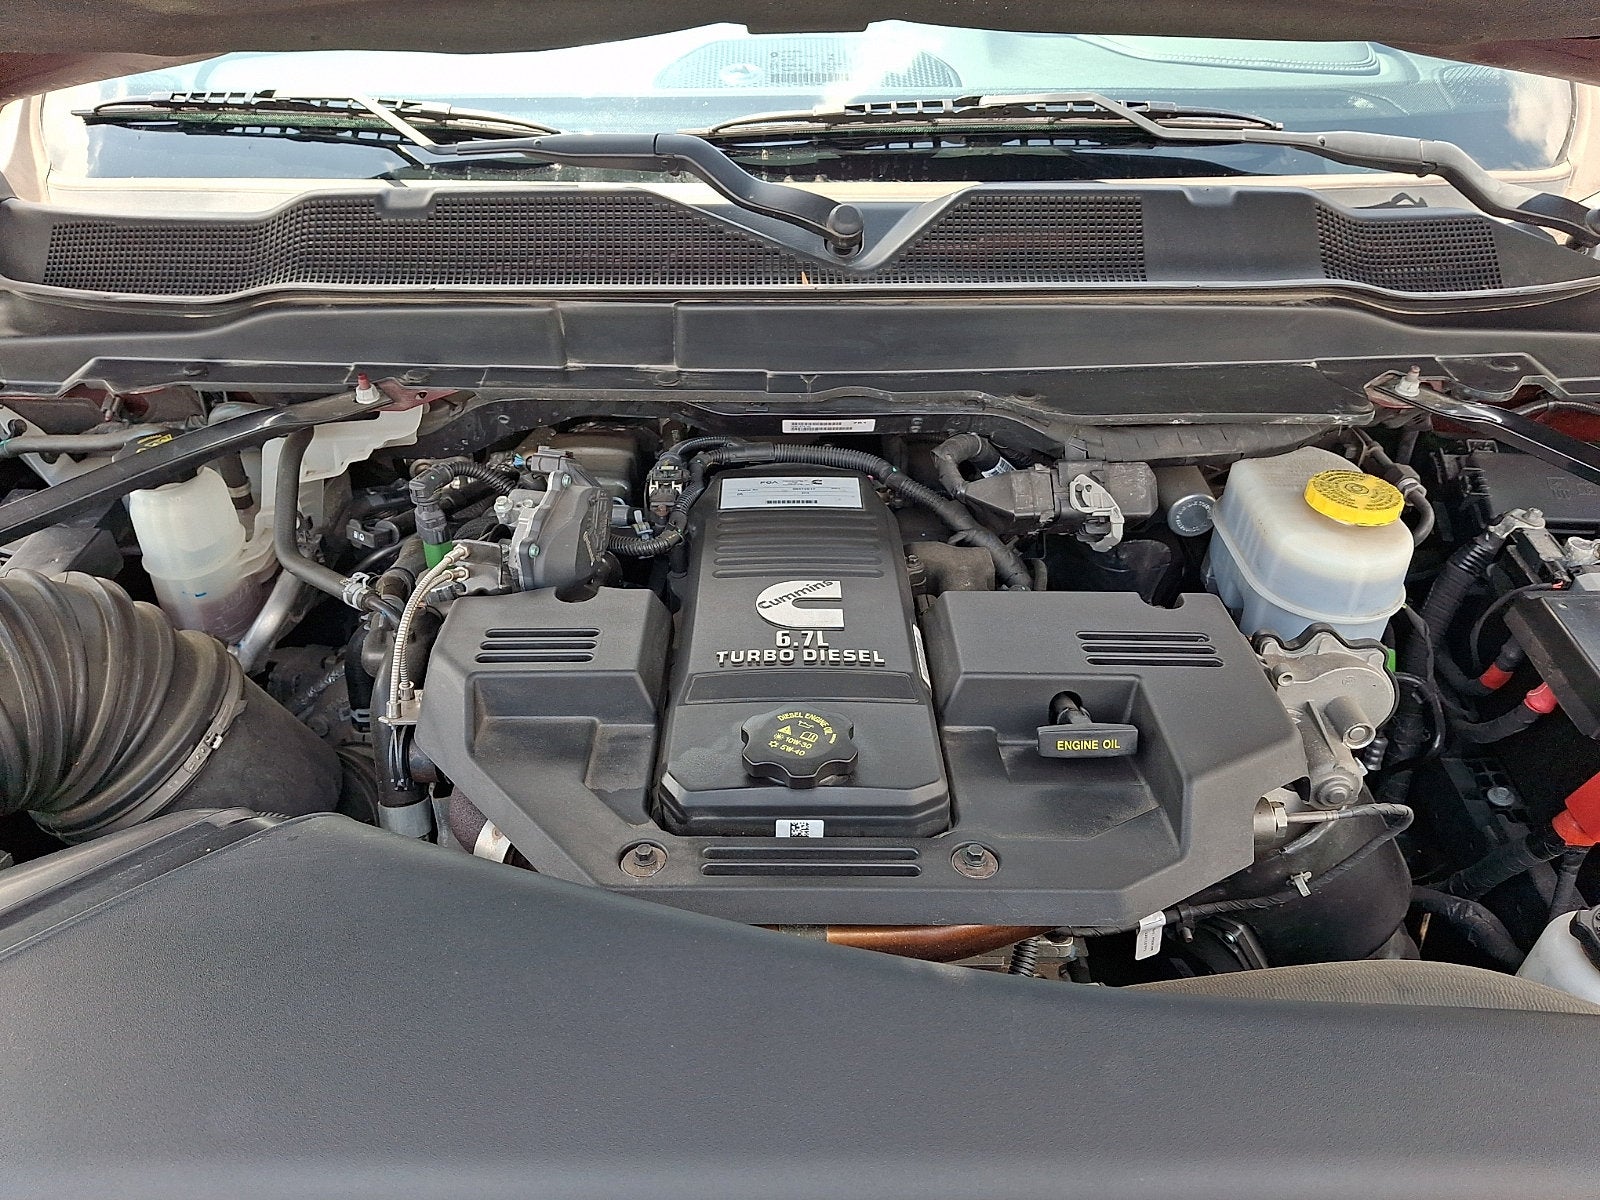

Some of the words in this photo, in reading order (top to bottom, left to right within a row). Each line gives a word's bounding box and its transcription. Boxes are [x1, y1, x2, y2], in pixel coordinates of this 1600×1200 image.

[757, 580, 834, 609] Cummins
[775, 630, 829, 648] 6.7L
[716, 649, 794, 665] TURBO
[803, 649, 885, 665] DIESEL
[777, 712, 803, 721] DIESEL
[804, 713, 830, 728] ENGINE
[780, 744, 806, 756] 5W-40
[785, 736, 813, 749] 10W-30
[1057, 740, 1099, 750] ENGINE
[1102, 739, 1120, 749] OIL
